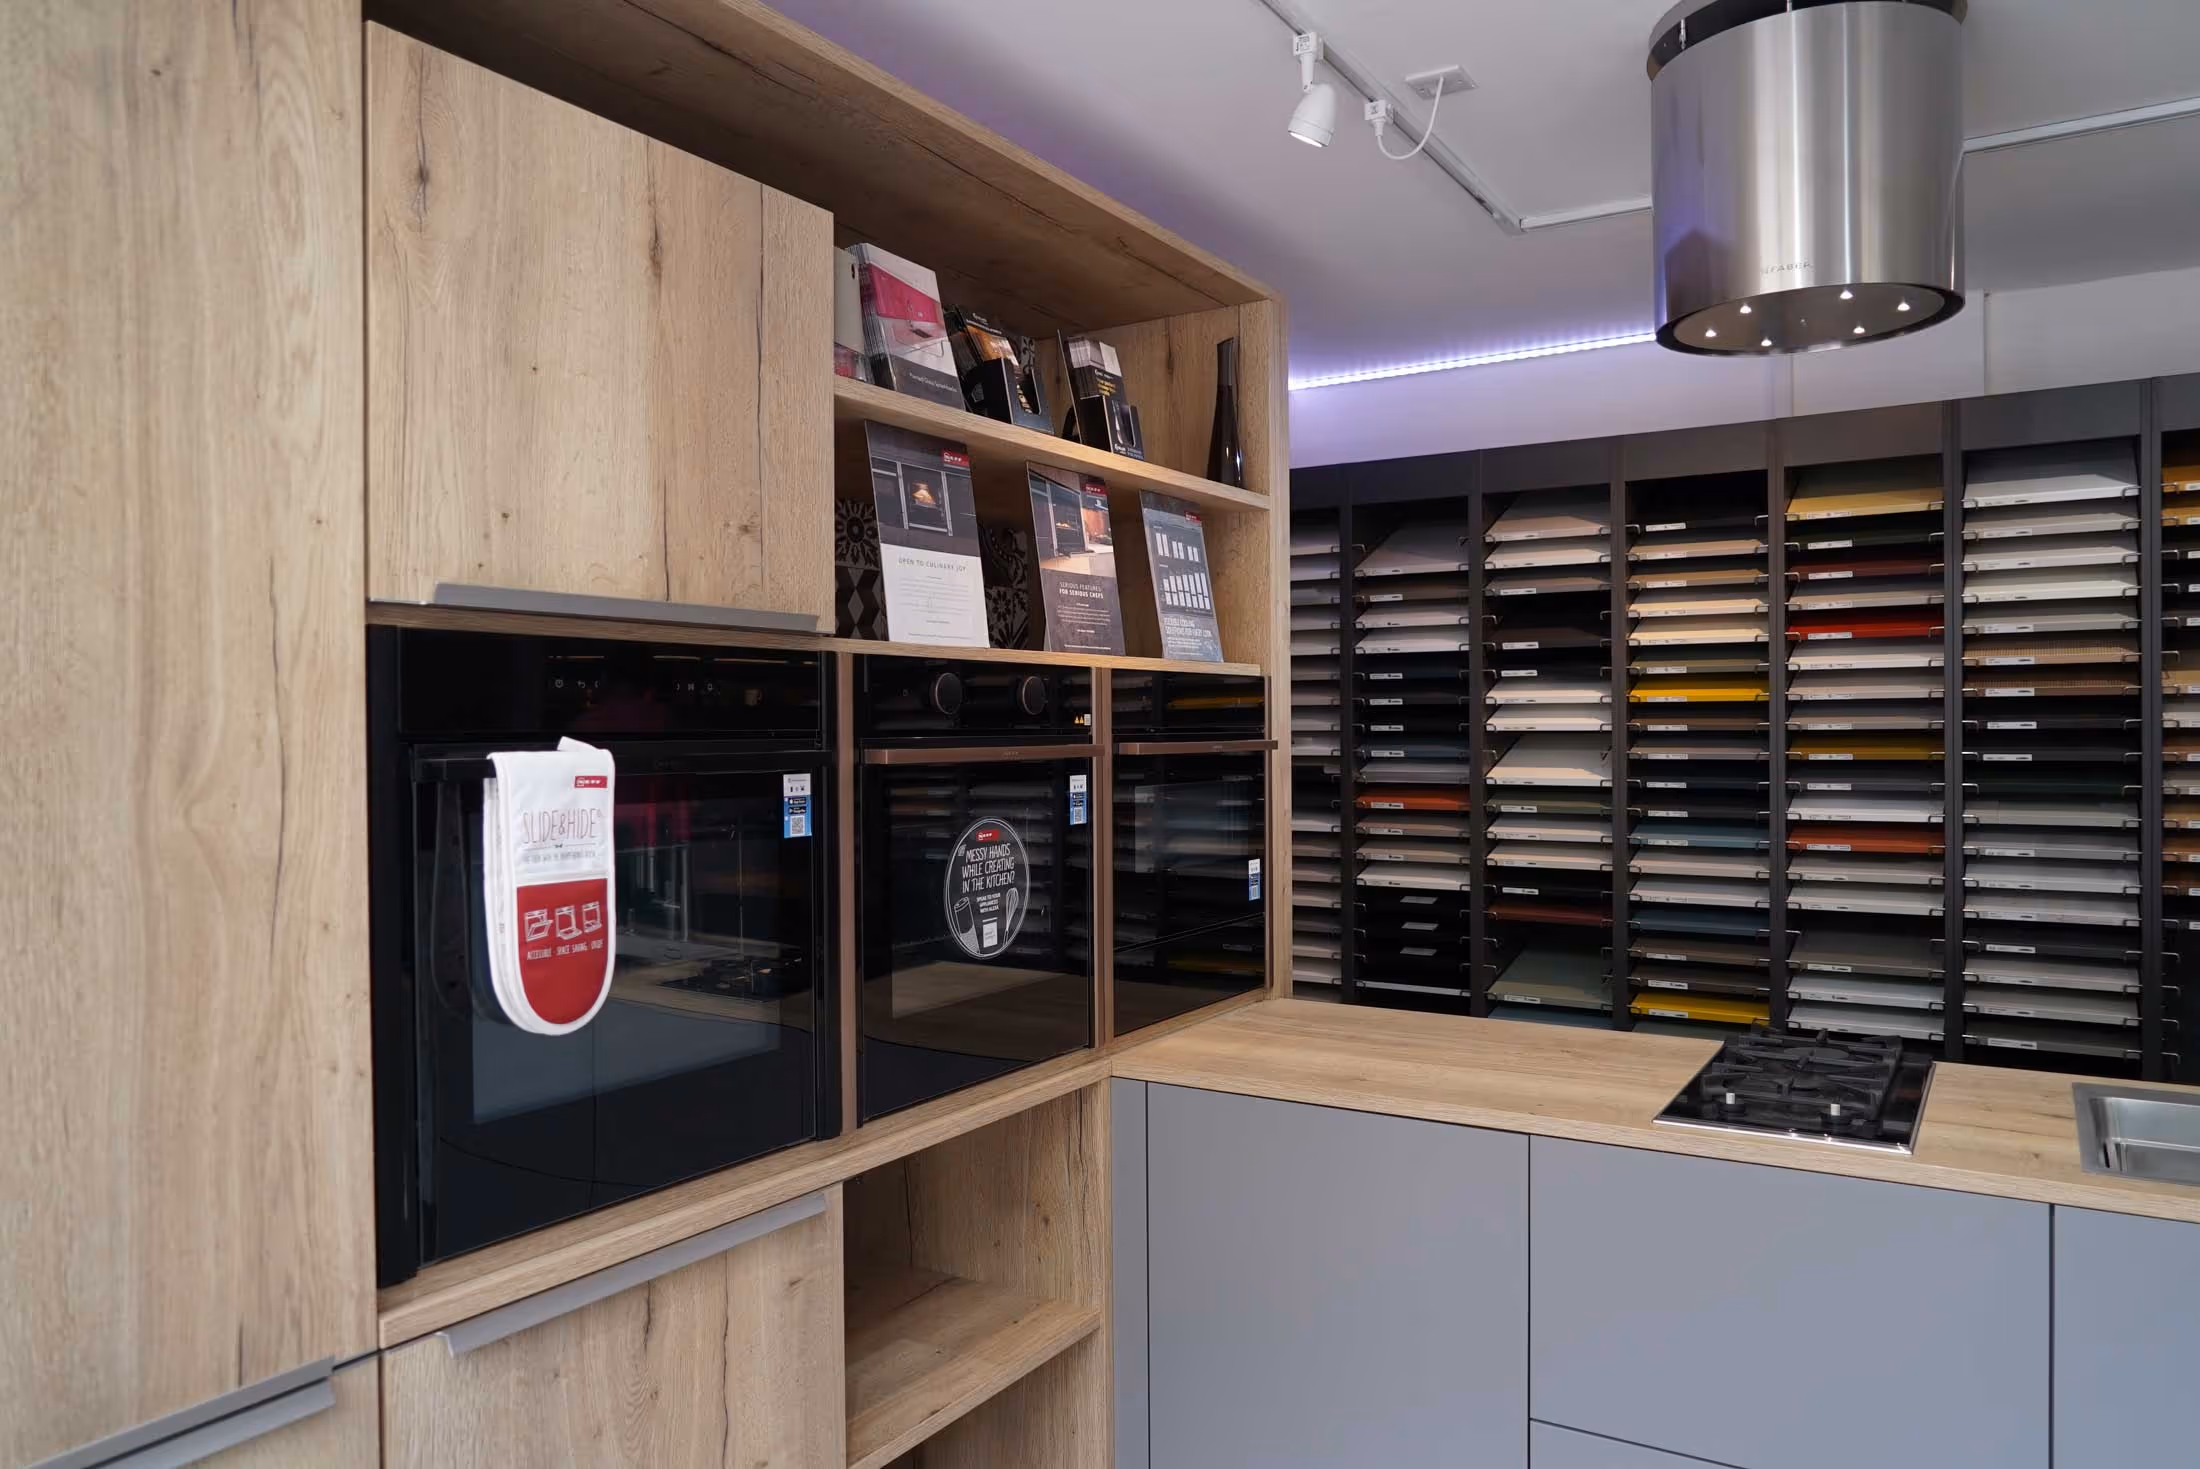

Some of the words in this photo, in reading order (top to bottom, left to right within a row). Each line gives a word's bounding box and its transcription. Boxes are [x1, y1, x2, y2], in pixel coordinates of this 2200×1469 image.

[966, 846, 987, 862] MESSY
[989, 843, 1011, 858] HANDS
[962, 862, 982, 878] WHILE
[985, 857, 1015, 875] CREATING
[963, 879, 970, 893] IN
[971, 876, 984, 891] THE
[986, 871, 1015, 888] KITCHEN?
